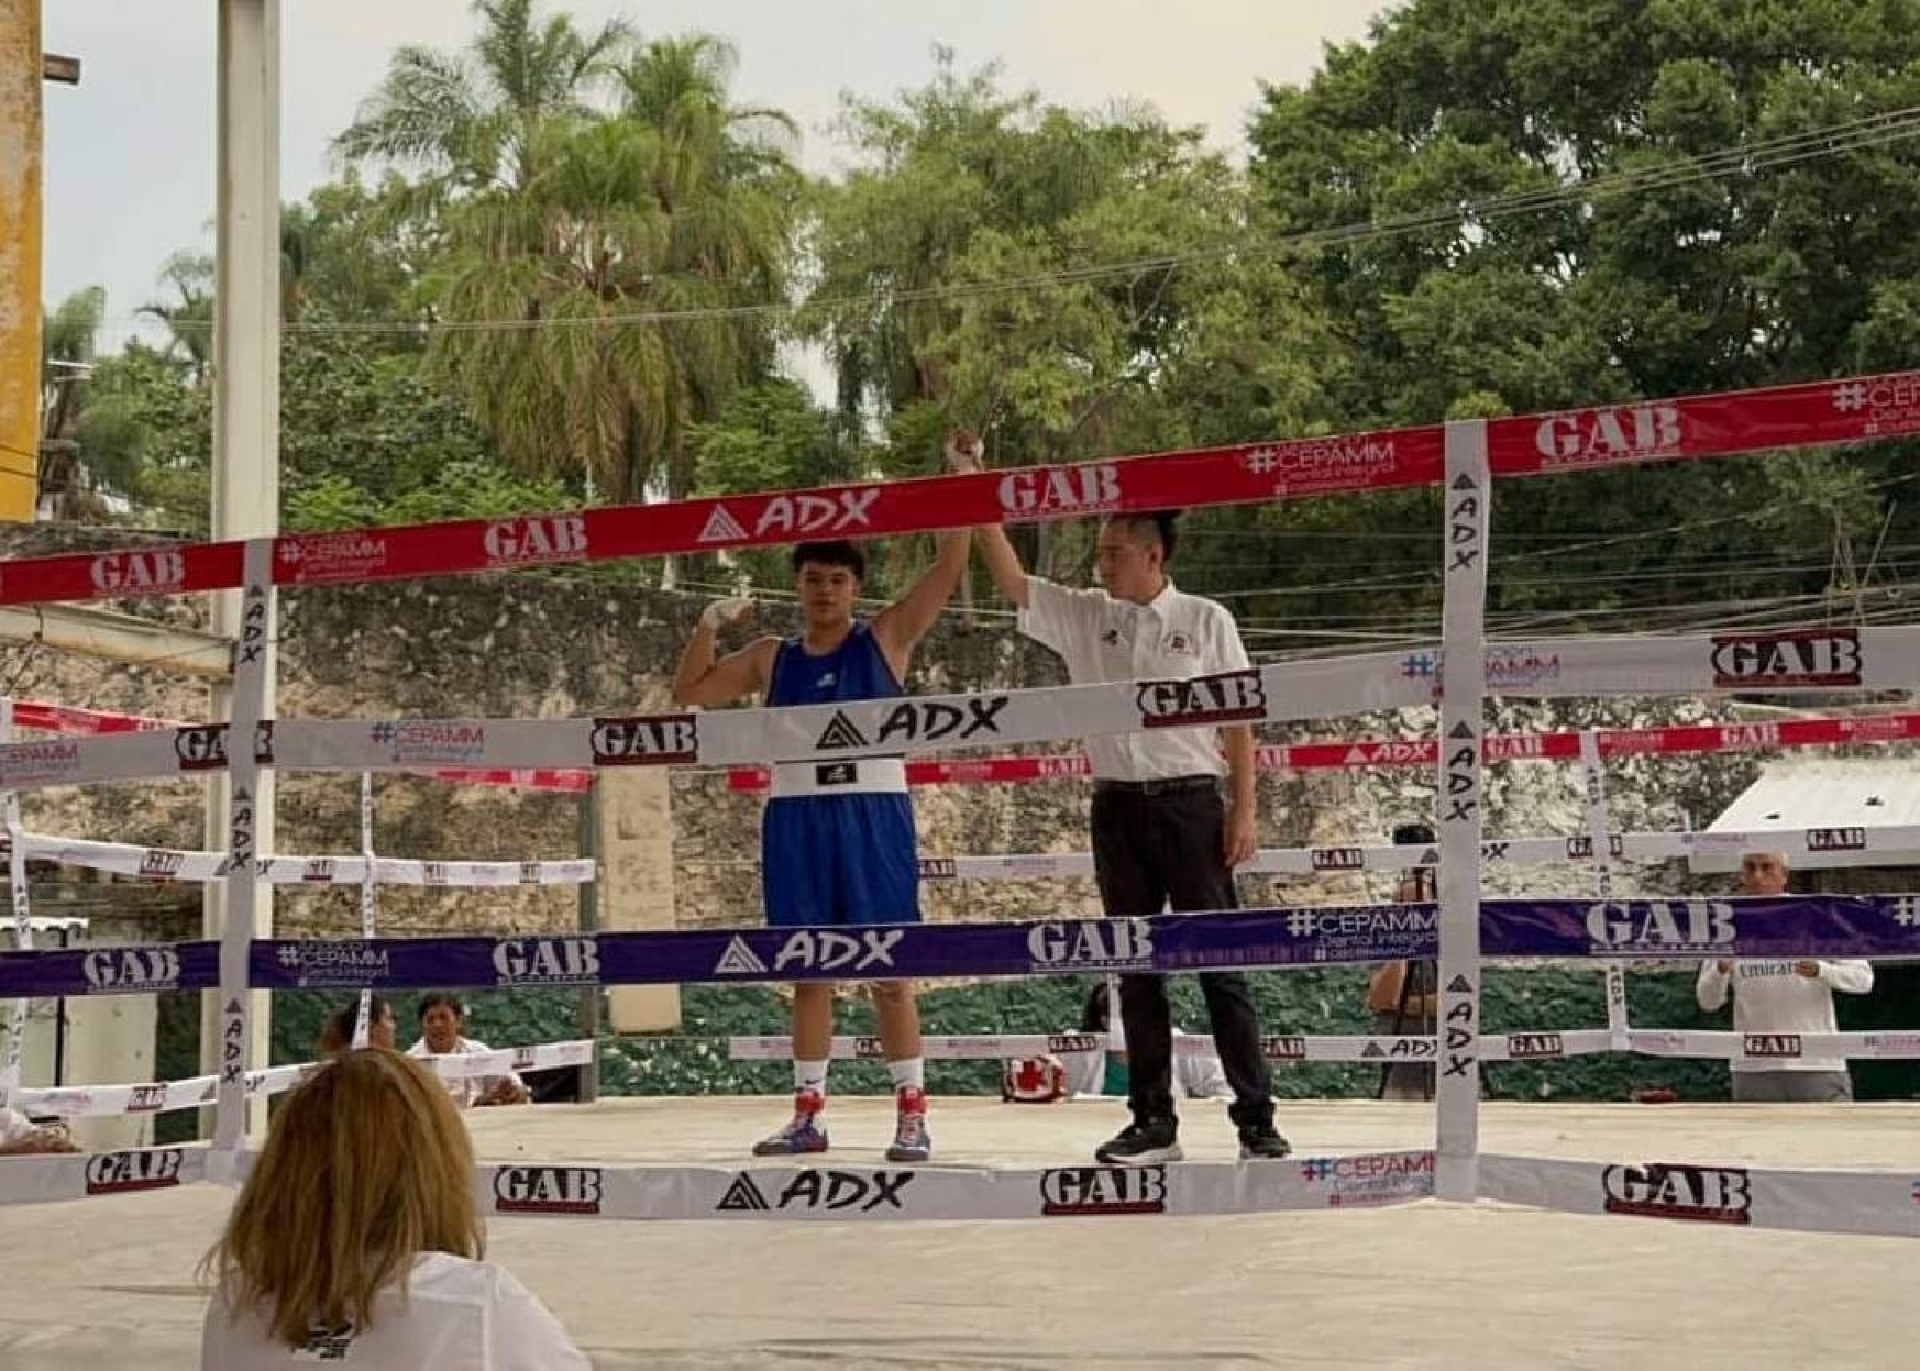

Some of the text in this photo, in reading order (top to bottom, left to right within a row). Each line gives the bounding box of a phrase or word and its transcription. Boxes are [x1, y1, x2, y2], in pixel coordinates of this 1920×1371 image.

[1536, 407, 1681, 457] GAB
[1247, 442, 1395, 474] #CEPAMM
[998, 464, 1121, 511] GAB
[757, 488, 880, 535] ADX
[484, 517, 588, 557] GAB
[1447, 498, 1479, 571] ADX
[91, 551, 185, 588] GAB
[239, 604, 266, 664] ADX
[1716, 639, 1858, 675] GAB
[1140, 677, 1264, 716] GAB
[876, 697, 1009, 743] ADX
[593, 723, 697, 757] GAB
[1258, 750, 1290, 768] AB
[1371, 744, 1434, 761] ADX
[1445, 747, 1476, 821] ADX
[230, 807, 251, 872] ADX
[1808, 829, 1863, 844] GAB
[1314, 851, 1362, 866] GAB
[1028, 920, 1152, 962] GAB
[1288, 908, 1438, 937] #CEPAMM
[1587, 903, 1736, 945] GAB
[84, 951, 181, 987] GAB
[493, 940, 600, 977] GAB
[774, 930, 904, 971] ADX
[222, 1018, 243, 1083] ADX
[1443, 1001, 1473, 1077] ADX
[1510, 1036, 1561, 1054] GAB
[1745, 1036, 1799, 1053] GAB
[88, 1151, 181, 1183] GAB
[497, 1169, 600, 1200] GAB
[1302, 1151, 1435, 1181] #CEPAM
[778, 1170, 914, 1212] ADX
[1043, 1168, 1165, 1204] GAB
[1607, 1166, 1747, 1209] GAB
